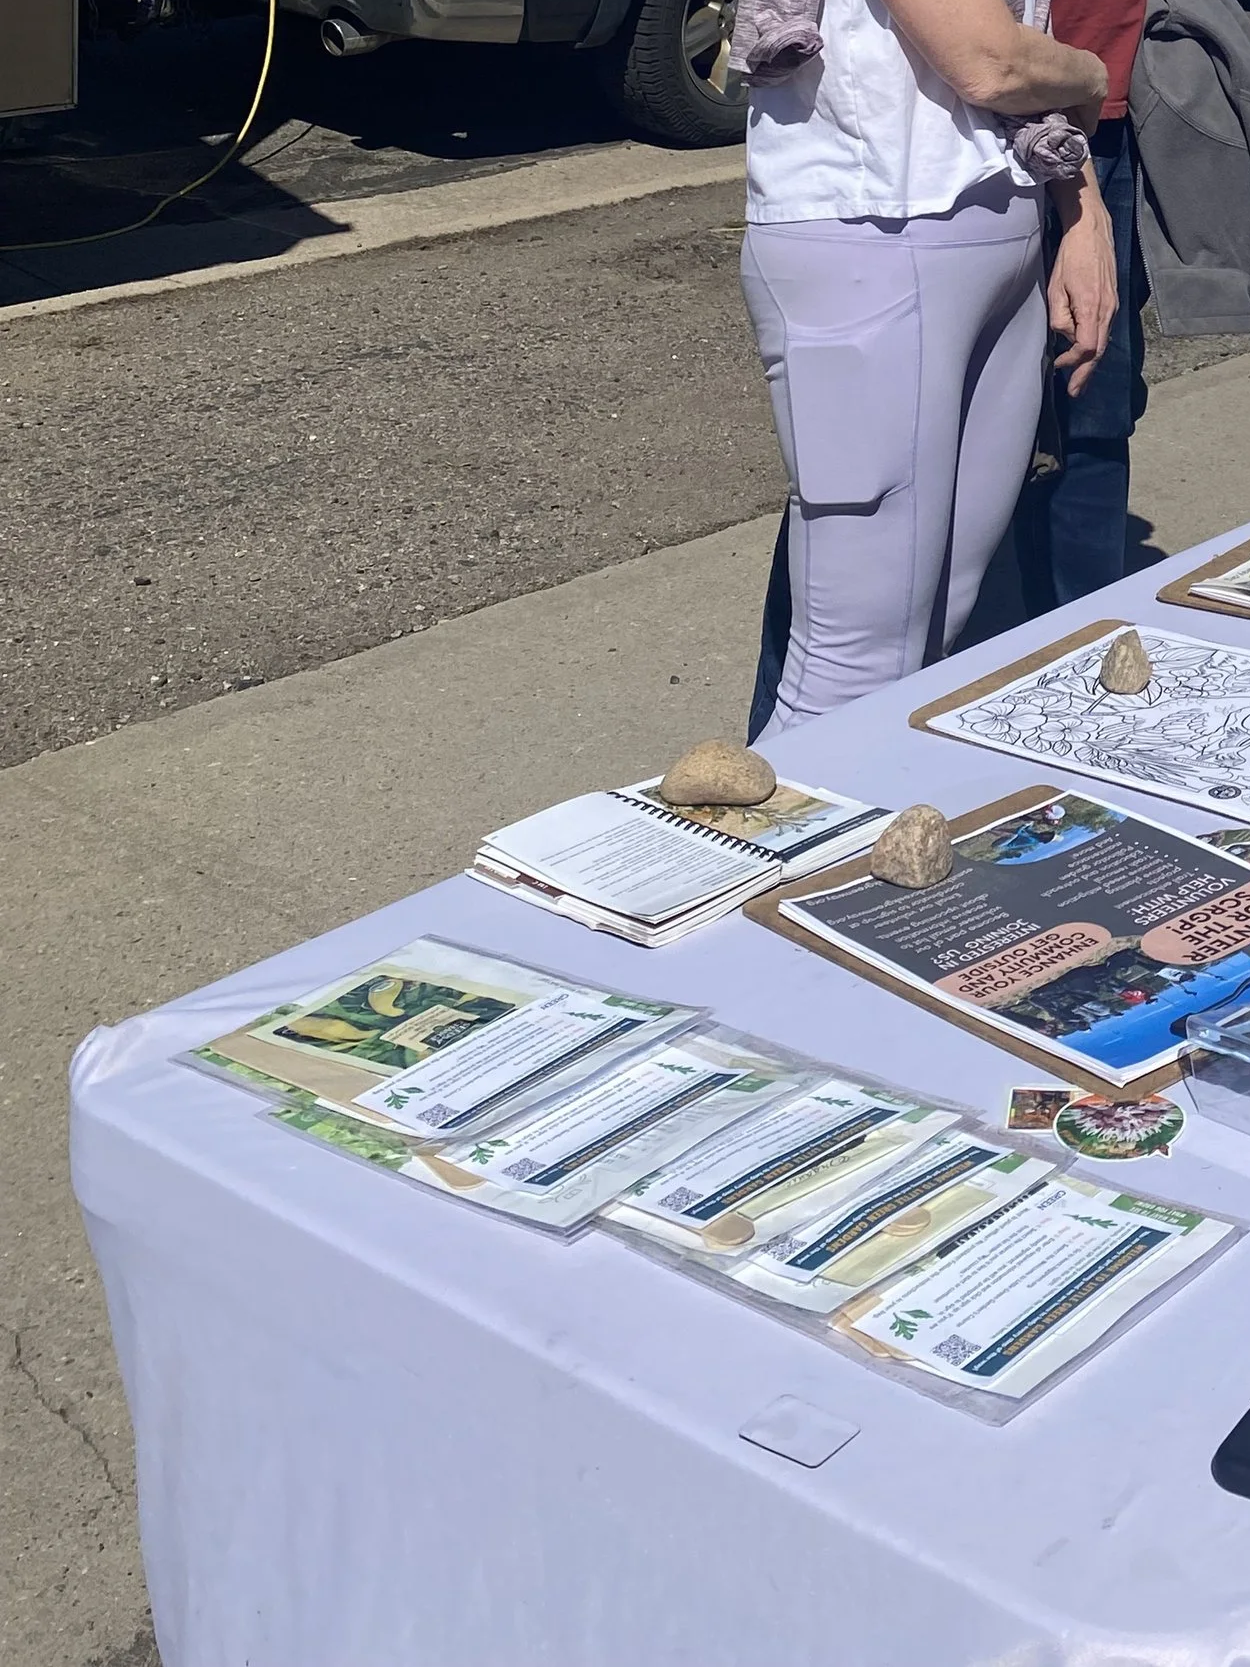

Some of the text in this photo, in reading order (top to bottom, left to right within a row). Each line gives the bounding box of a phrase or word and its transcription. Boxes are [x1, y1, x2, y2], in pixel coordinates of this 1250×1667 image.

[1094, 836, 1113, 847] And
[1040, 849, 1143, 896] Education and outreach
[1059, 864, 1090, 880] garden
[1102, 874, 1127, 887] weed
[1104, 876, 1142, 894] planting
[1127, 873, 1214, 914] HELP WITH:
[1135, 878, 1234, 924] VOLUNTEERS
[910, 906, 958, 927] upcoming
[944, 929, 967, 941] part
[968, 912, 1009, 930] Become
[1181, 921, 1232, 945] THE
[930, 919, 1027, 964] JOINING US?
[932, 939, 946, 947] of
[938, 923, 1039, 970] INTERESTED IN
[958, 933, 1059, 980] GET OUTSIDE
[958, 932, 1084, 992] COMMUITY AND
[970, 938, 1098, 997] ENHANCE YOUR
[826, 1160, 974, 1252] WELCOME TO LITTLE GREEN GARDENS
[1003, 1244, 1146, 1354] WELCOME TO LITTLE GREEN GARDENS
